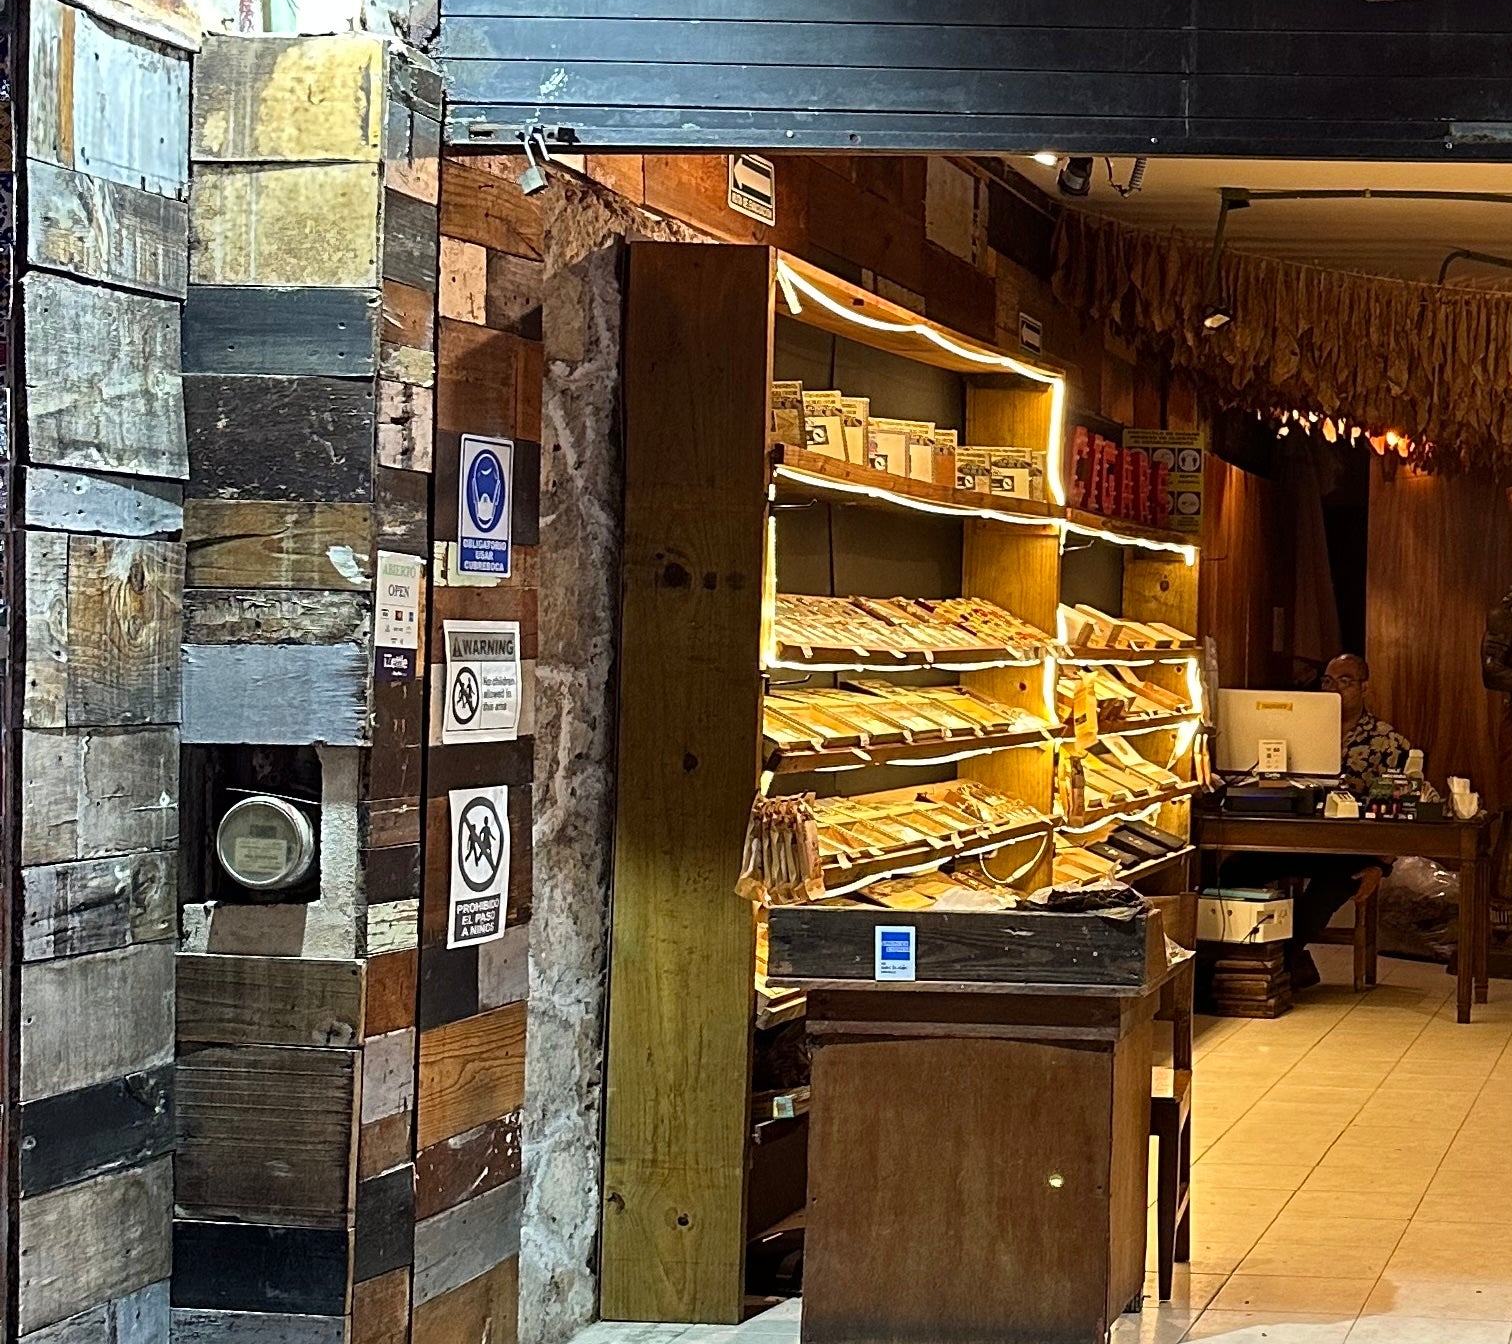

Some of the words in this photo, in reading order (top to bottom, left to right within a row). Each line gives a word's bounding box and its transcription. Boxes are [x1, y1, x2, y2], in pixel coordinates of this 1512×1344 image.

[475, 550, 494, 560] USAR
[382, 563, 416, 578] ABIERTO
[388, 584, 410, 598] OPEN
[463, 639, 514, 655] WARNING
[457, 898, 500, 915] PROHIBIDO
[462, 915, 473, 925] EL
[475, 910, 496, 924] PASO
[461, 926, 469, 937] A
